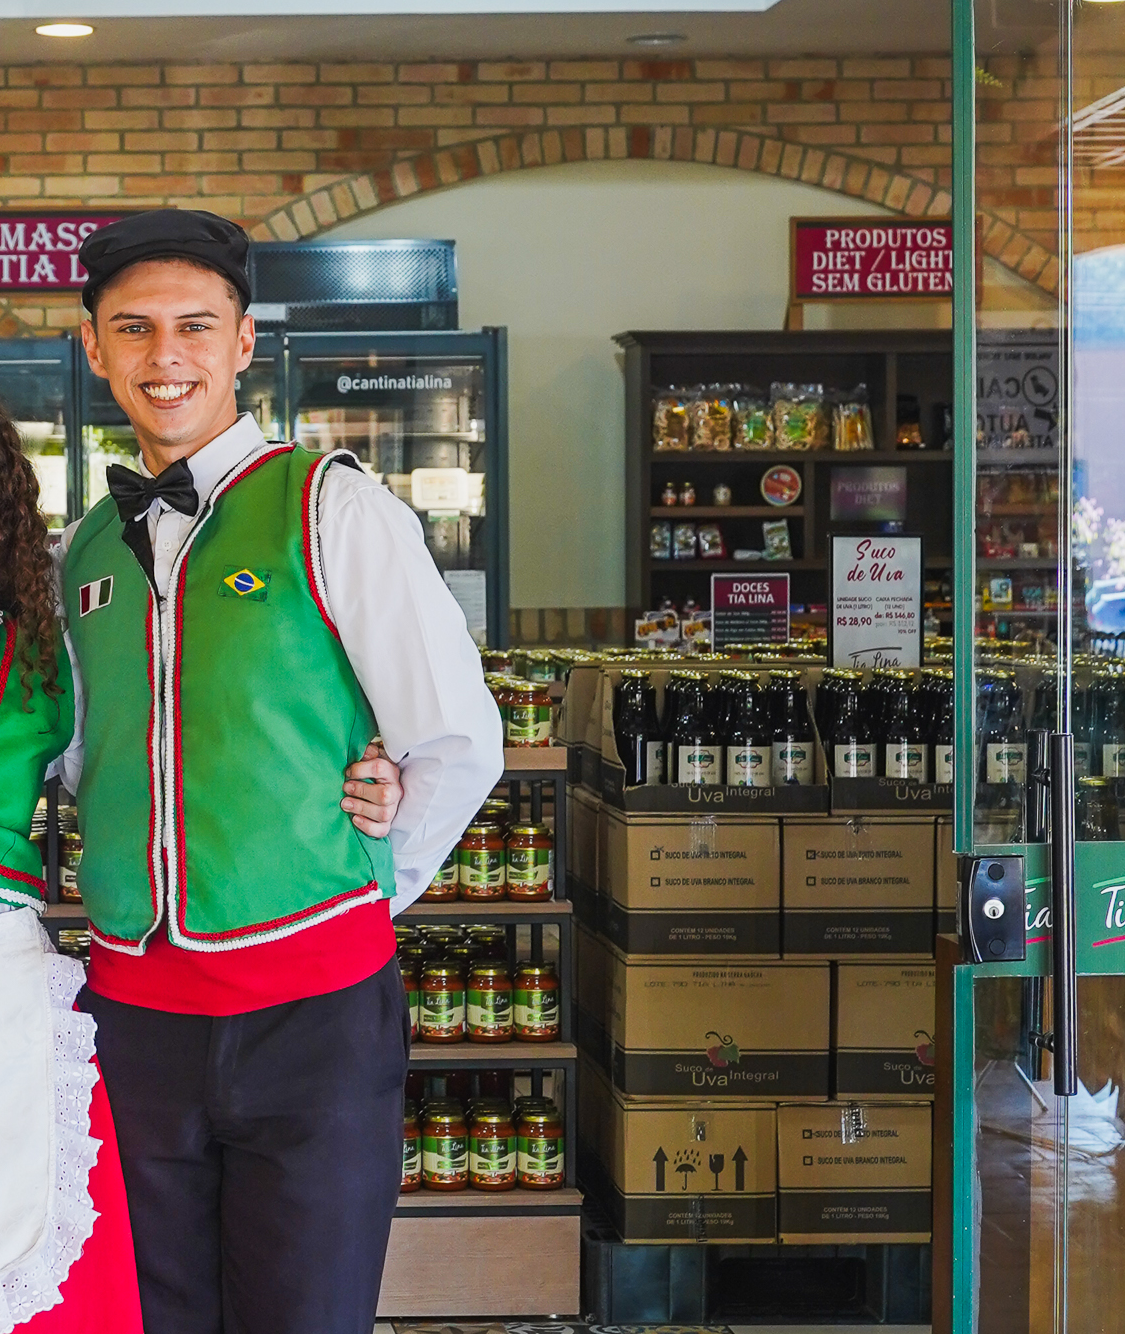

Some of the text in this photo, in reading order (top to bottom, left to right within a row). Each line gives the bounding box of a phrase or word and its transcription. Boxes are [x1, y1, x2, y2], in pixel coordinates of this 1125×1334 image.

[825, 228, 947, 249] PRODUTOS
[812, 250, 866, 271] DIET
[812, 272, 861, 293] SEM
[336, 375, 452, 394] @cantinatialina
[856, 538, 896, 561] Suco
[847, 562, 905, 582] de Uva
[732, 582, 770, 593] DOCES
[727, 593, 775, 604] TIA LINA
[836, 617, 872, 627] R$ 28,90
[878, 778, 905, 787] Suco
[688, 786, 775, 803] Uva Integral
[896, 785, 932, 800] Uva
[665, 851, 681, 859] SUCO
[682, 851, 690, 859] DE
[720, 851, 747, 859] INTEGRAL
[820, 850, 836, 858] SUCO
[837, 850, 845, 858] DE
[875, 850, 902, 858] INTEGRAL
[665, 878, 755, 886] SUCO DE UVA BRANCO INTEGRAL
[820, 877, 910, 885] SUCO DE UVA BRANCO INTEGRAL
[1025, 887, 1053, 930] ia
[1100, 885, 1125, 929] Ti
[675, 1064, 702, 1073] Suco
[692, 1071, 728, 1086] Uva
[729, 1070, 779, 1082] Integral
[883, 1062, 911, 1072] Suco
[901, 1070, 935, 1085] Uva
[871, 1129, 899, 1137] INTEGRAL
[818, 1156, 907, 1165] SUCO DE UVA BRANCO INTEGRAL
